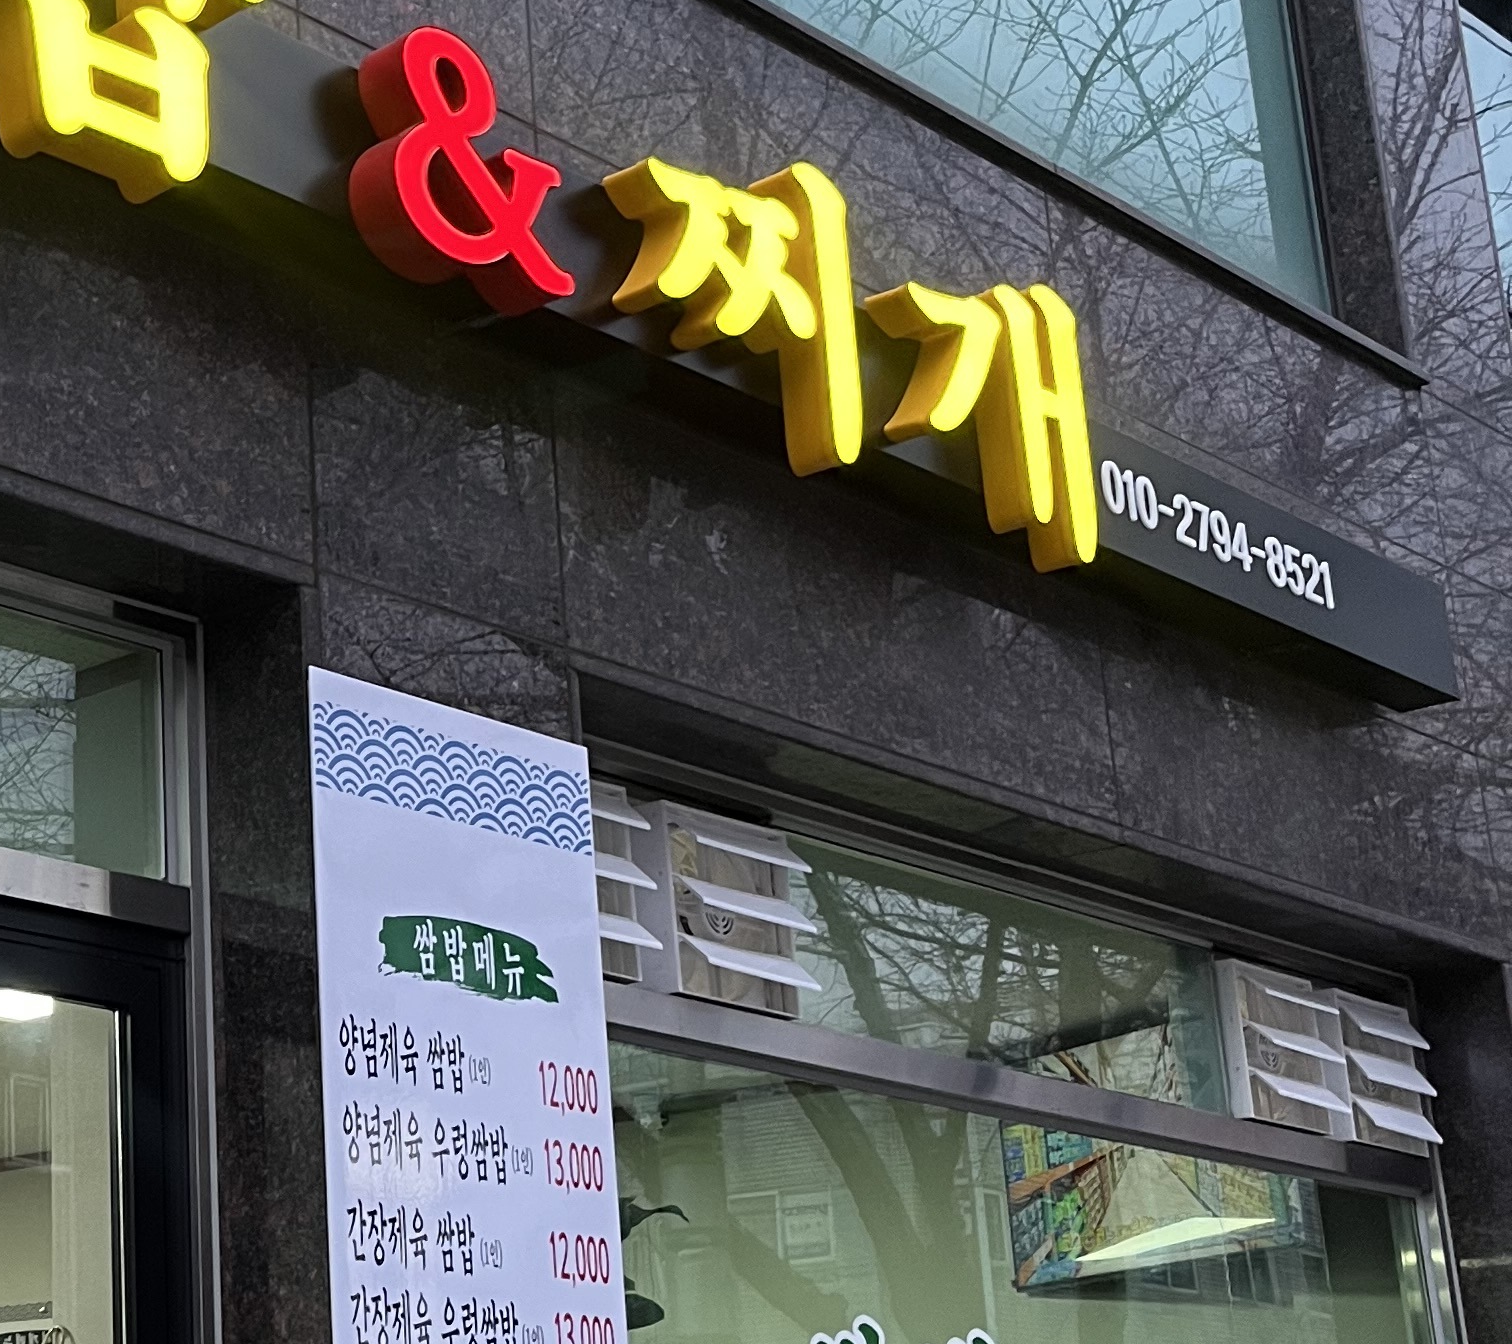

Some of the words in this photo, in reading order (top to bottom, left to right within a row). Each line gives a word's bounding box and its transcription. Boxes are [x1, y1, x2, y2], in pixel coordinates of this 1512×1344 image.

[348, 24, 576, 317] &
[602, 154, 1099, 574] 찌개
[1100, 459, 1337, 610] 010-2794-8521
[339, 1013, 419, 1087] 양념제육
[426, 1030, 465, 1095] 쌈밥
[468, 1054, 492, 1087] (1인)
[538, 1060, 599, 1116] 12,000
[342, 1100, 423, 1174] 양념제육
[431, 1117, 509, 1185] 우렁쌈밥
[511, 1145, 534, 1177] (1인)
[543, 1138, 604, 1194] 13,000
[346, 1198, 429, 1271] 간장제육
[436, 1210, 475, 1277] 쌈밥
[479, 1237, 503, 1270] (1인)
[549, 1231, 610, 1288] 12,000
